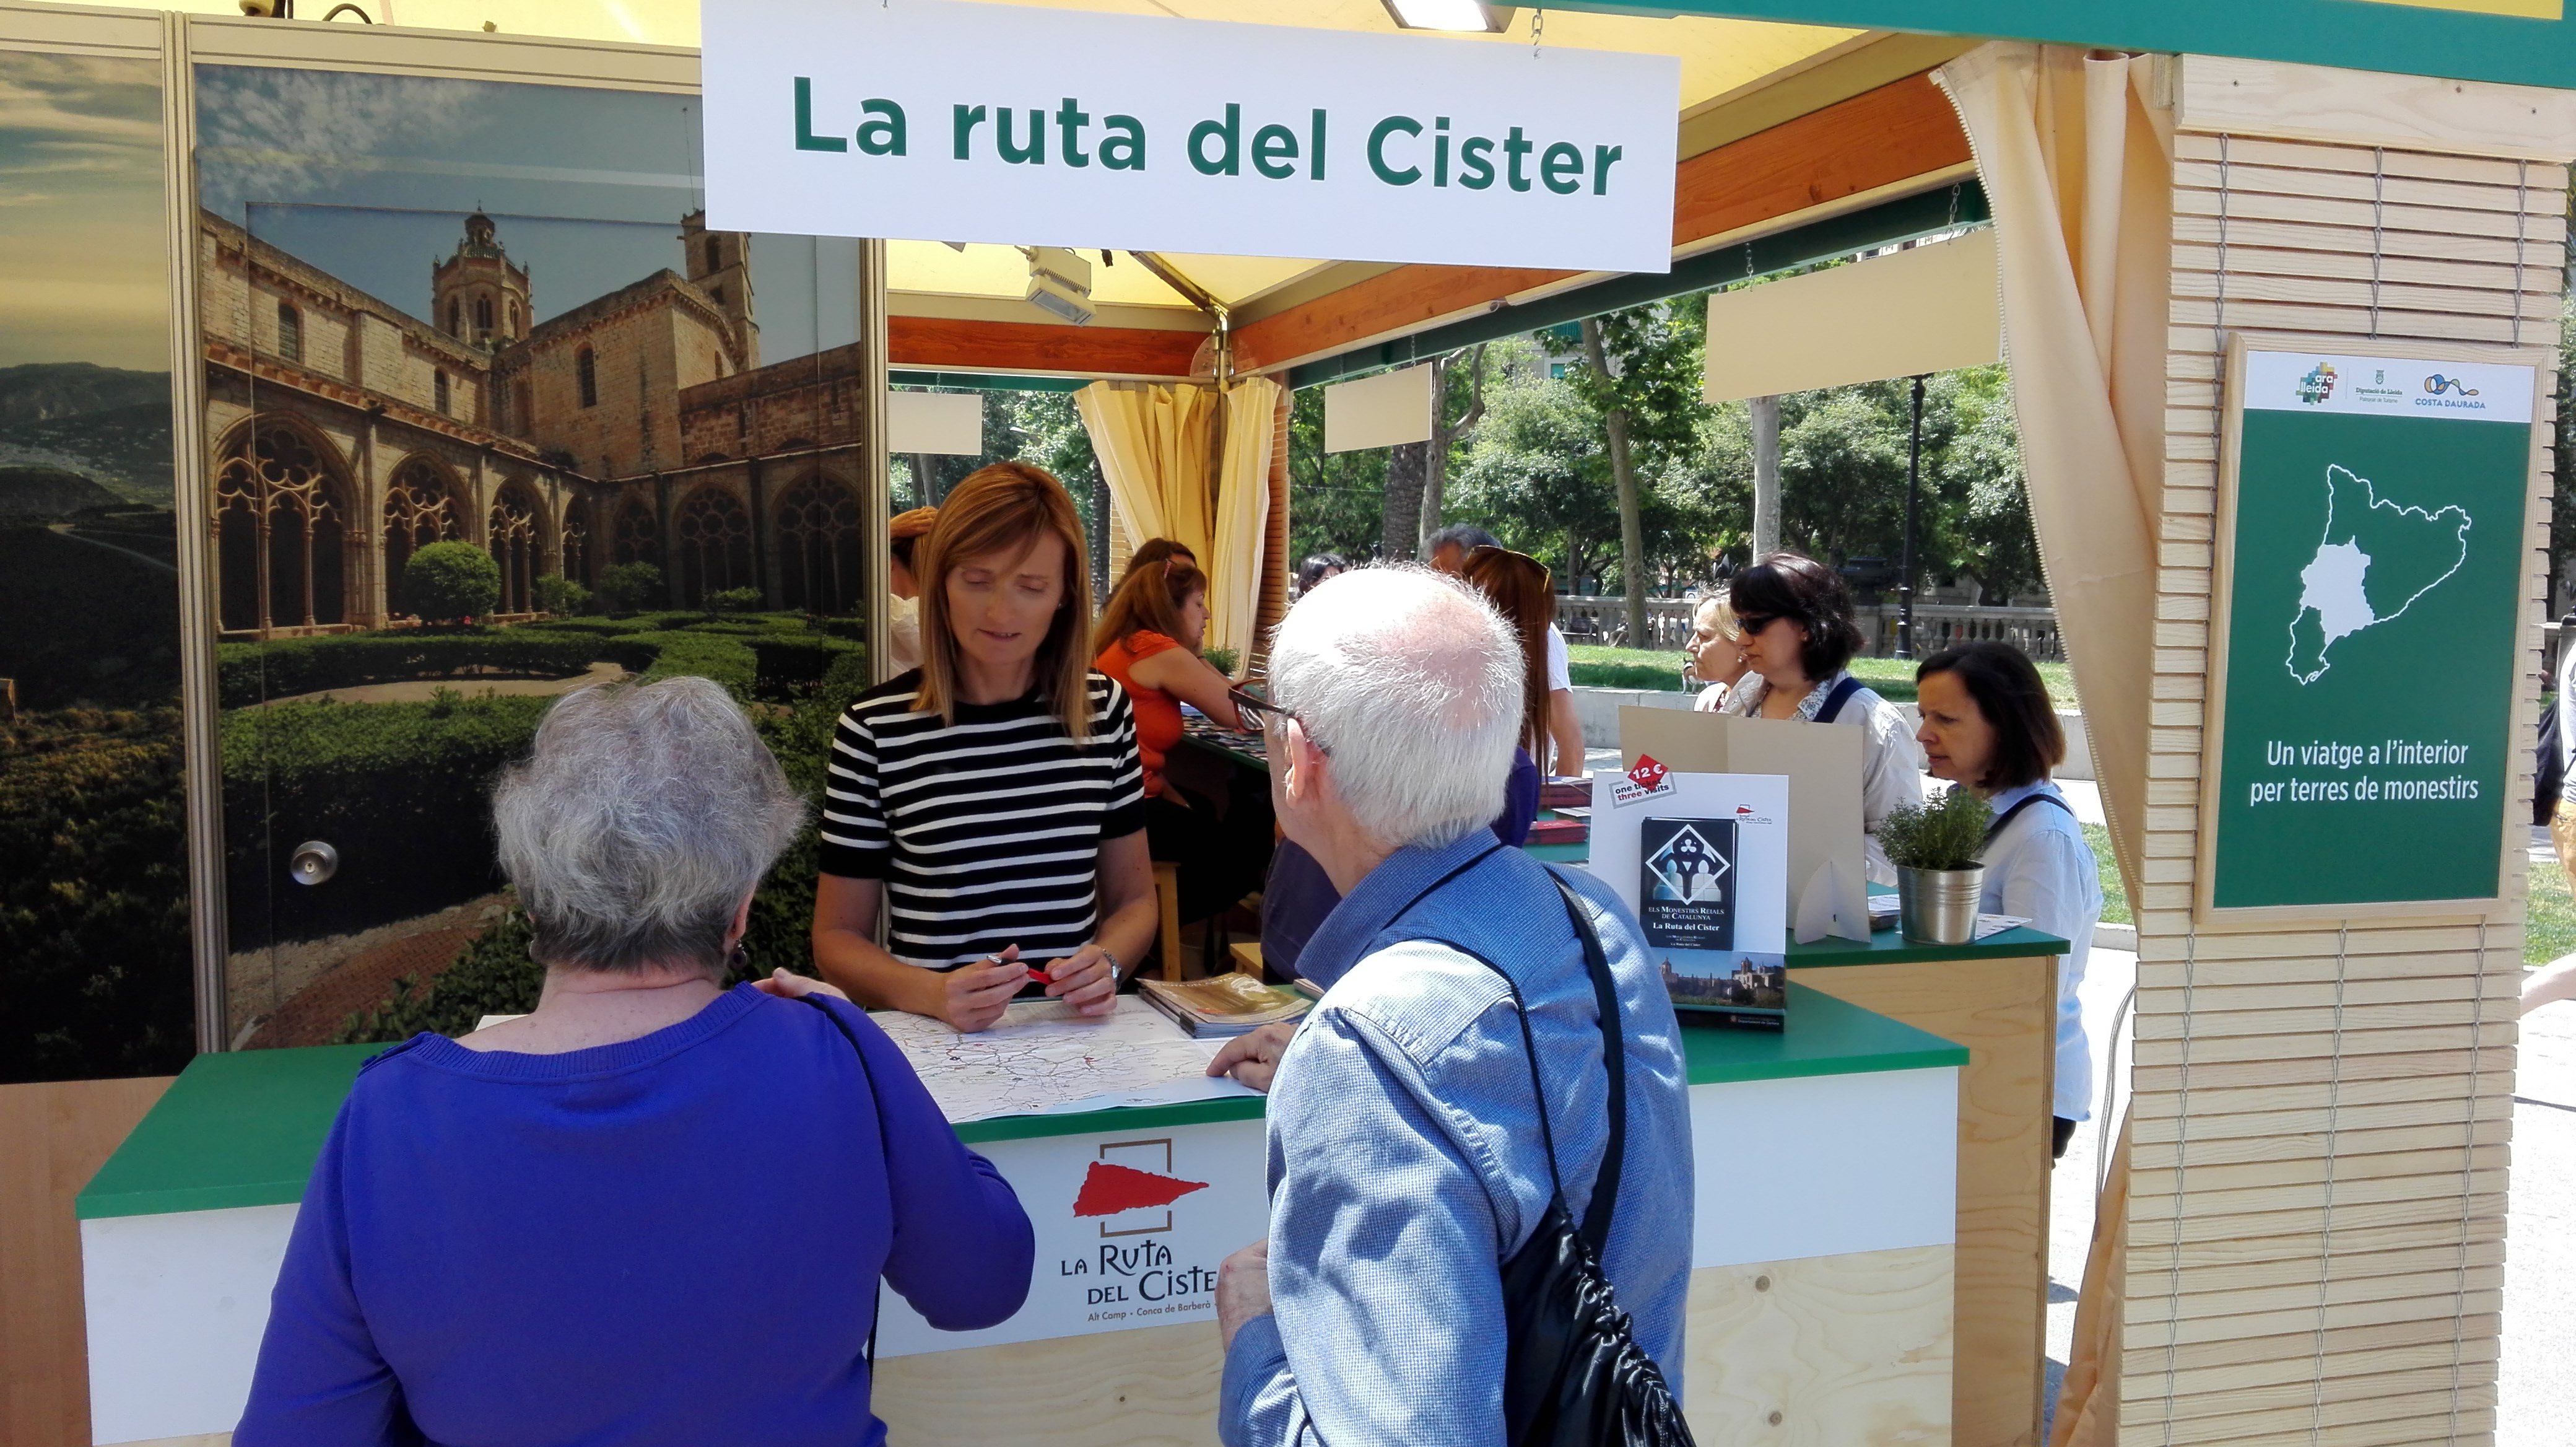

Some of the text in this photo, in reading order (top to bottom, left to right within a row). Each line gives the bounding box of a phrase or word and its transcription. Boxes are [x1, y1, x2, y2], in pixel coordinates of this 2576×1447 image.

[792, 77, 1622, 196] La ruta del Cister
[2315, 375, 2333, 383] ara
[2300, 382, 2328, 393] lleida
[2356, 387, 2379, 395] Diputació
[2415, 398, 2486, 409] COSTA DAURADA
[2268, 740, 2294, 765] Un
[2301, 740, 2363, 769] viatge
[2369, 746, 2380, 764] a
[1633, 764, 1663, 779] 12 €
[1616, 779, 1661, 794] one ticket
[1617, 785, 1669, 800] three visits
[2250, 776, 2478, 807] per terres de monestirs
[1061, 1240, 1172, 1276] LA RUTA
[1087, 1287, 1128, 1305] DEL
[1088, 1300, 1211, 1322] Alt Camp Conca de Barberà
